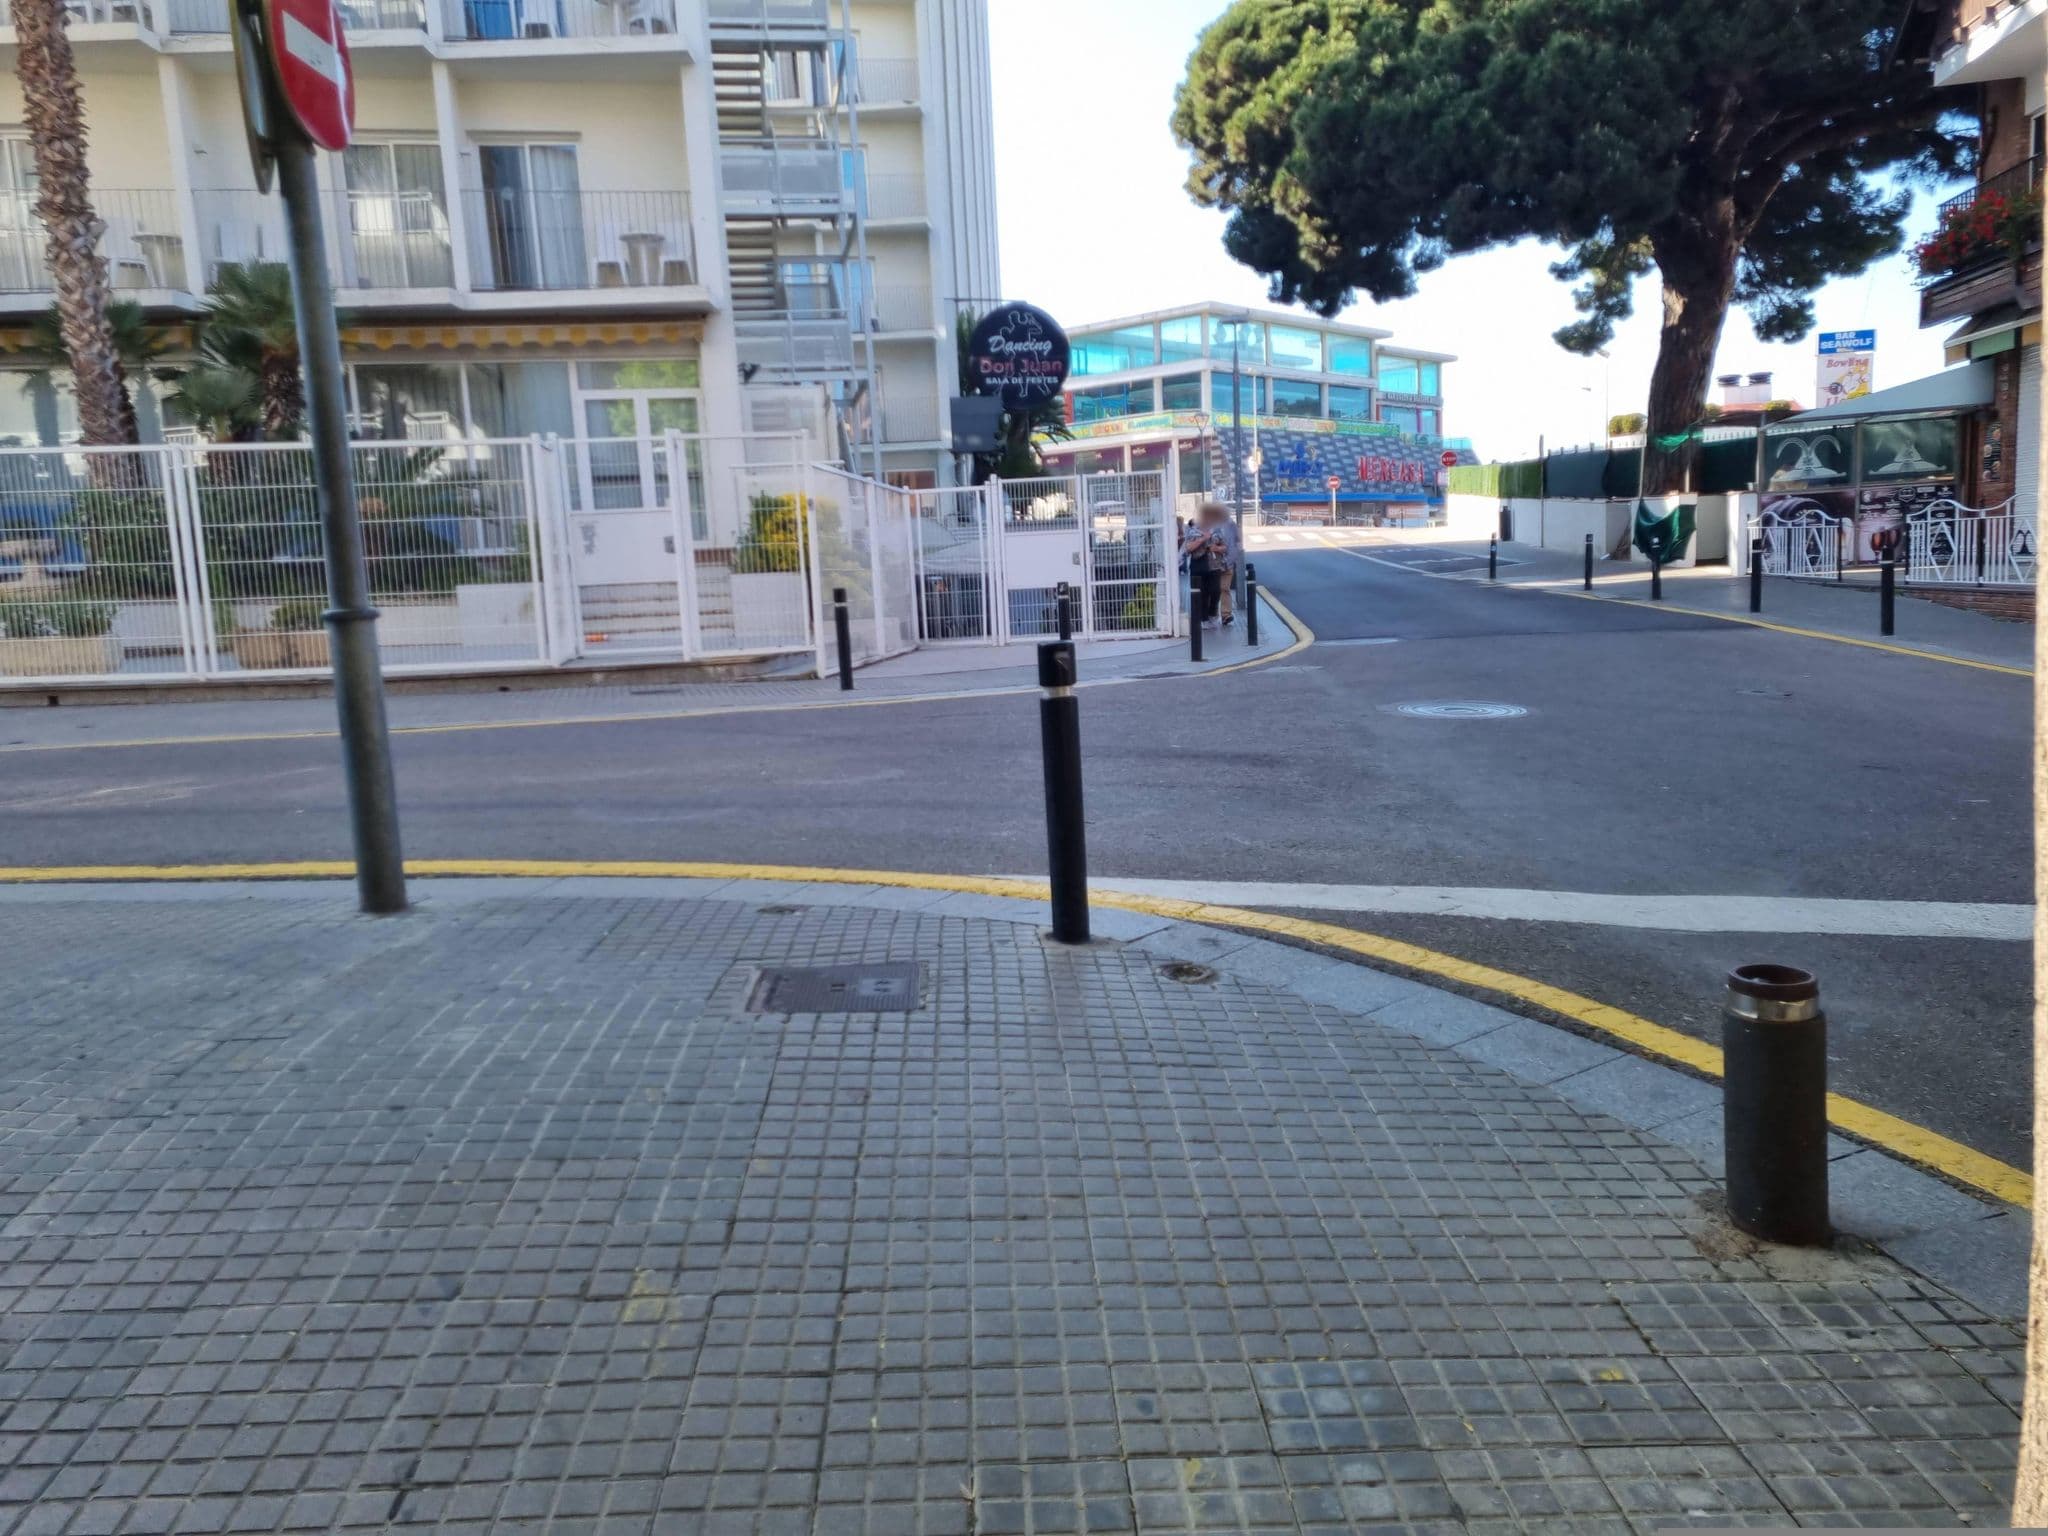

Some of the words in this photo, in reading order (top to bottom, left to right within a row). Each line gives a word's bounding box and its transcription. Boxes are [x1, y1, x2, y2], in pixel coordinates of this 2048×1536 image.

[1835, 332, 1856, 340] BAR
[988, 335, 1053, 356] Dancing
[1820, 338, 1872, 349] SEAWOLF
[979, 358, 1014, 374] Don
[1021, 358, 1062, 374] Juan
[1826, 357, 1869, 369] Bowling
[986, 377, 1009, 385] SALA
[1026, 376, 1058, 384] FESTES
